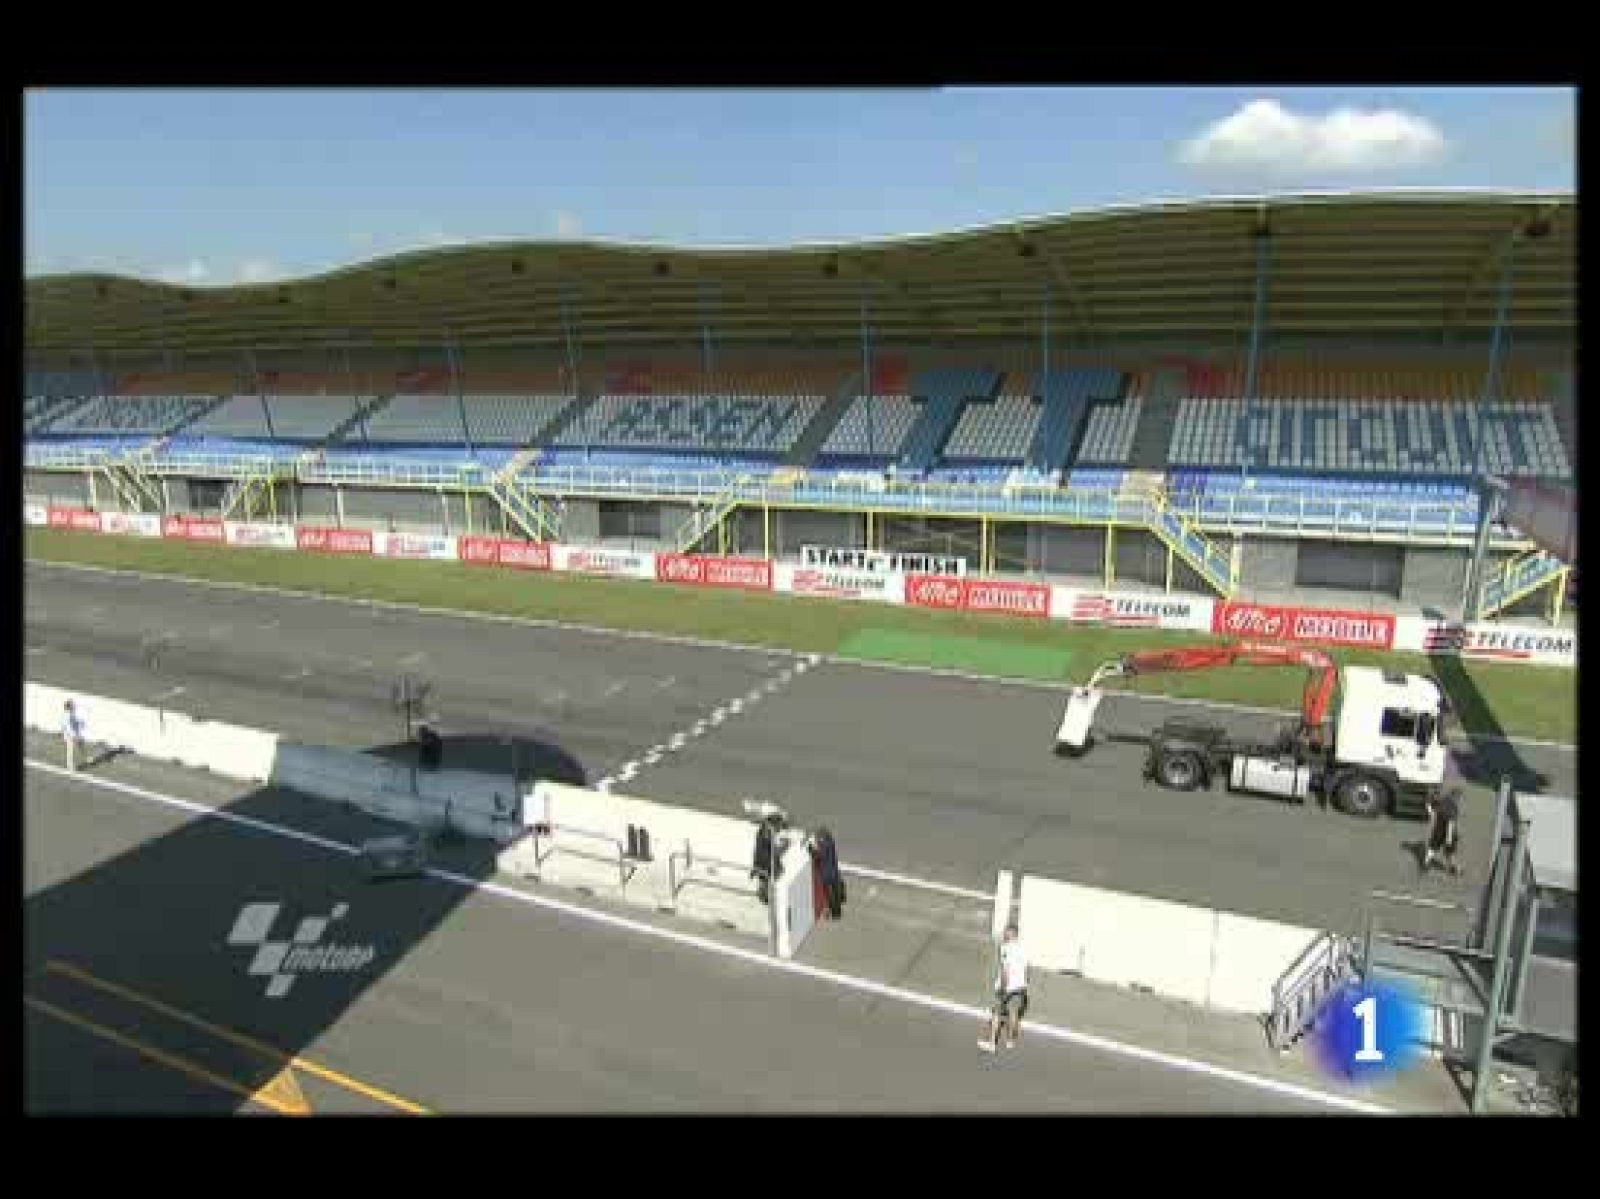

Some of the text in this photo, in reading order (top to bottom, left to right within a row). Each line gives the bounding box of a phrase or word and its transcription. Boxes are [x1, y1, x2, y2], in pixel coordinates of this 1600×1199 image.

[807, 548, 865, 569] START
[889, 555, 959, 574] FINISH
[1115, 598, 1191, 618] TELECOM
[1476, 629, 1574, 654] TELECOM
